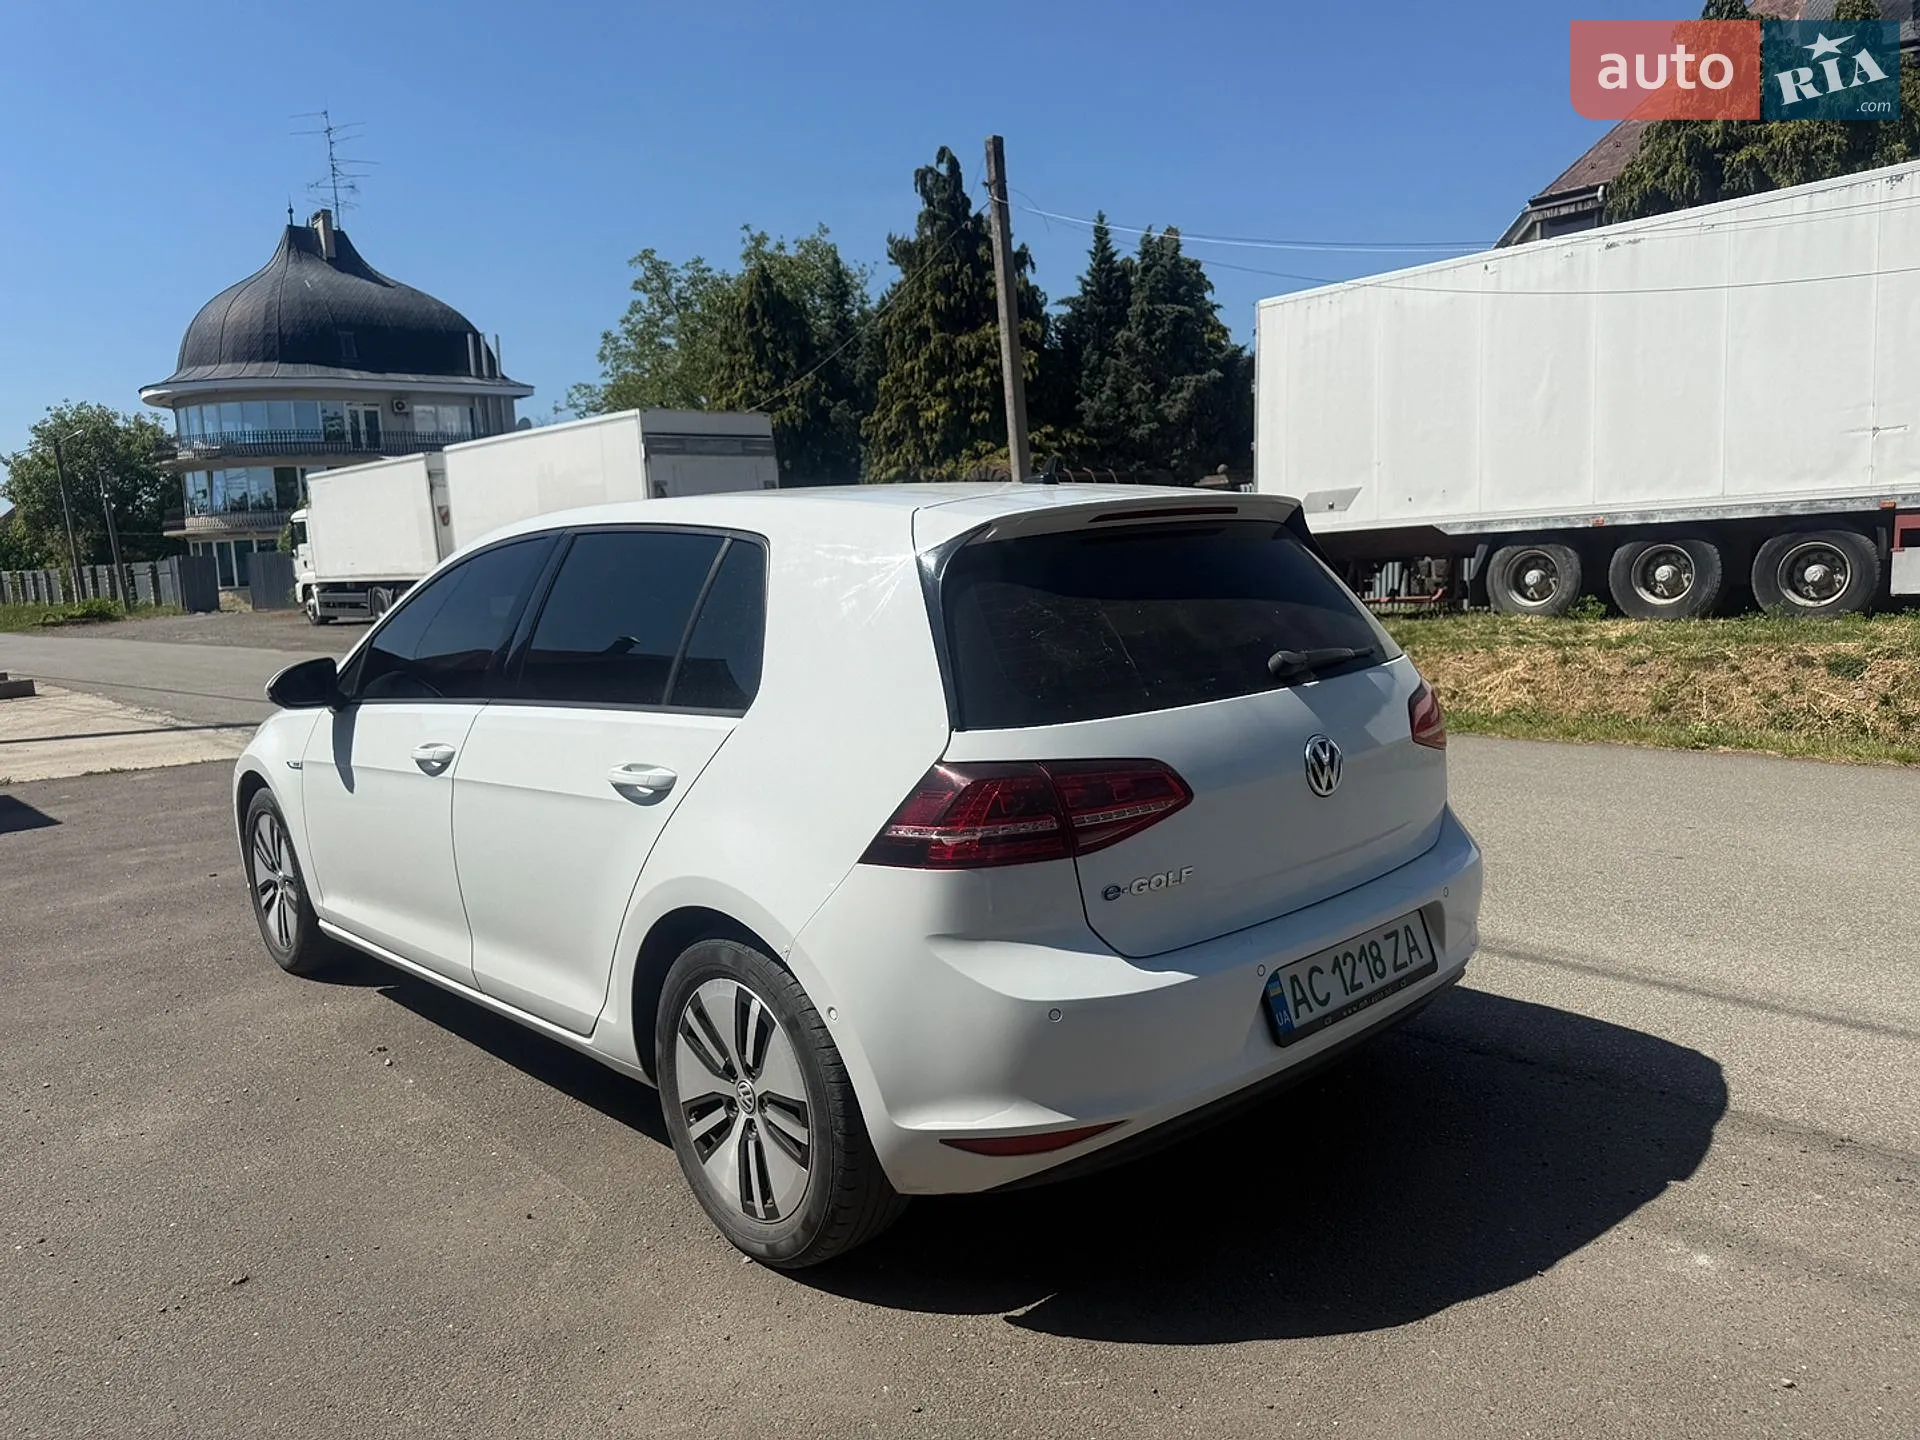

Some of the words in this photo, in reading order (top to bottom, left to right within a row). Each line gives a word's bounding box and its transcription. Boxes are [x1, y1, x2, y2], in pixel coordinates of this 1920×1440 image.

[1102, 865, 1193, 901] e-GOLF
[1289, 965, 1331, 1020] AC
[1331, 940, 1387, 996] 1218
[1383, 924, 1424, 973] ZA
[1276, 1013, 1292, 1027] UA
